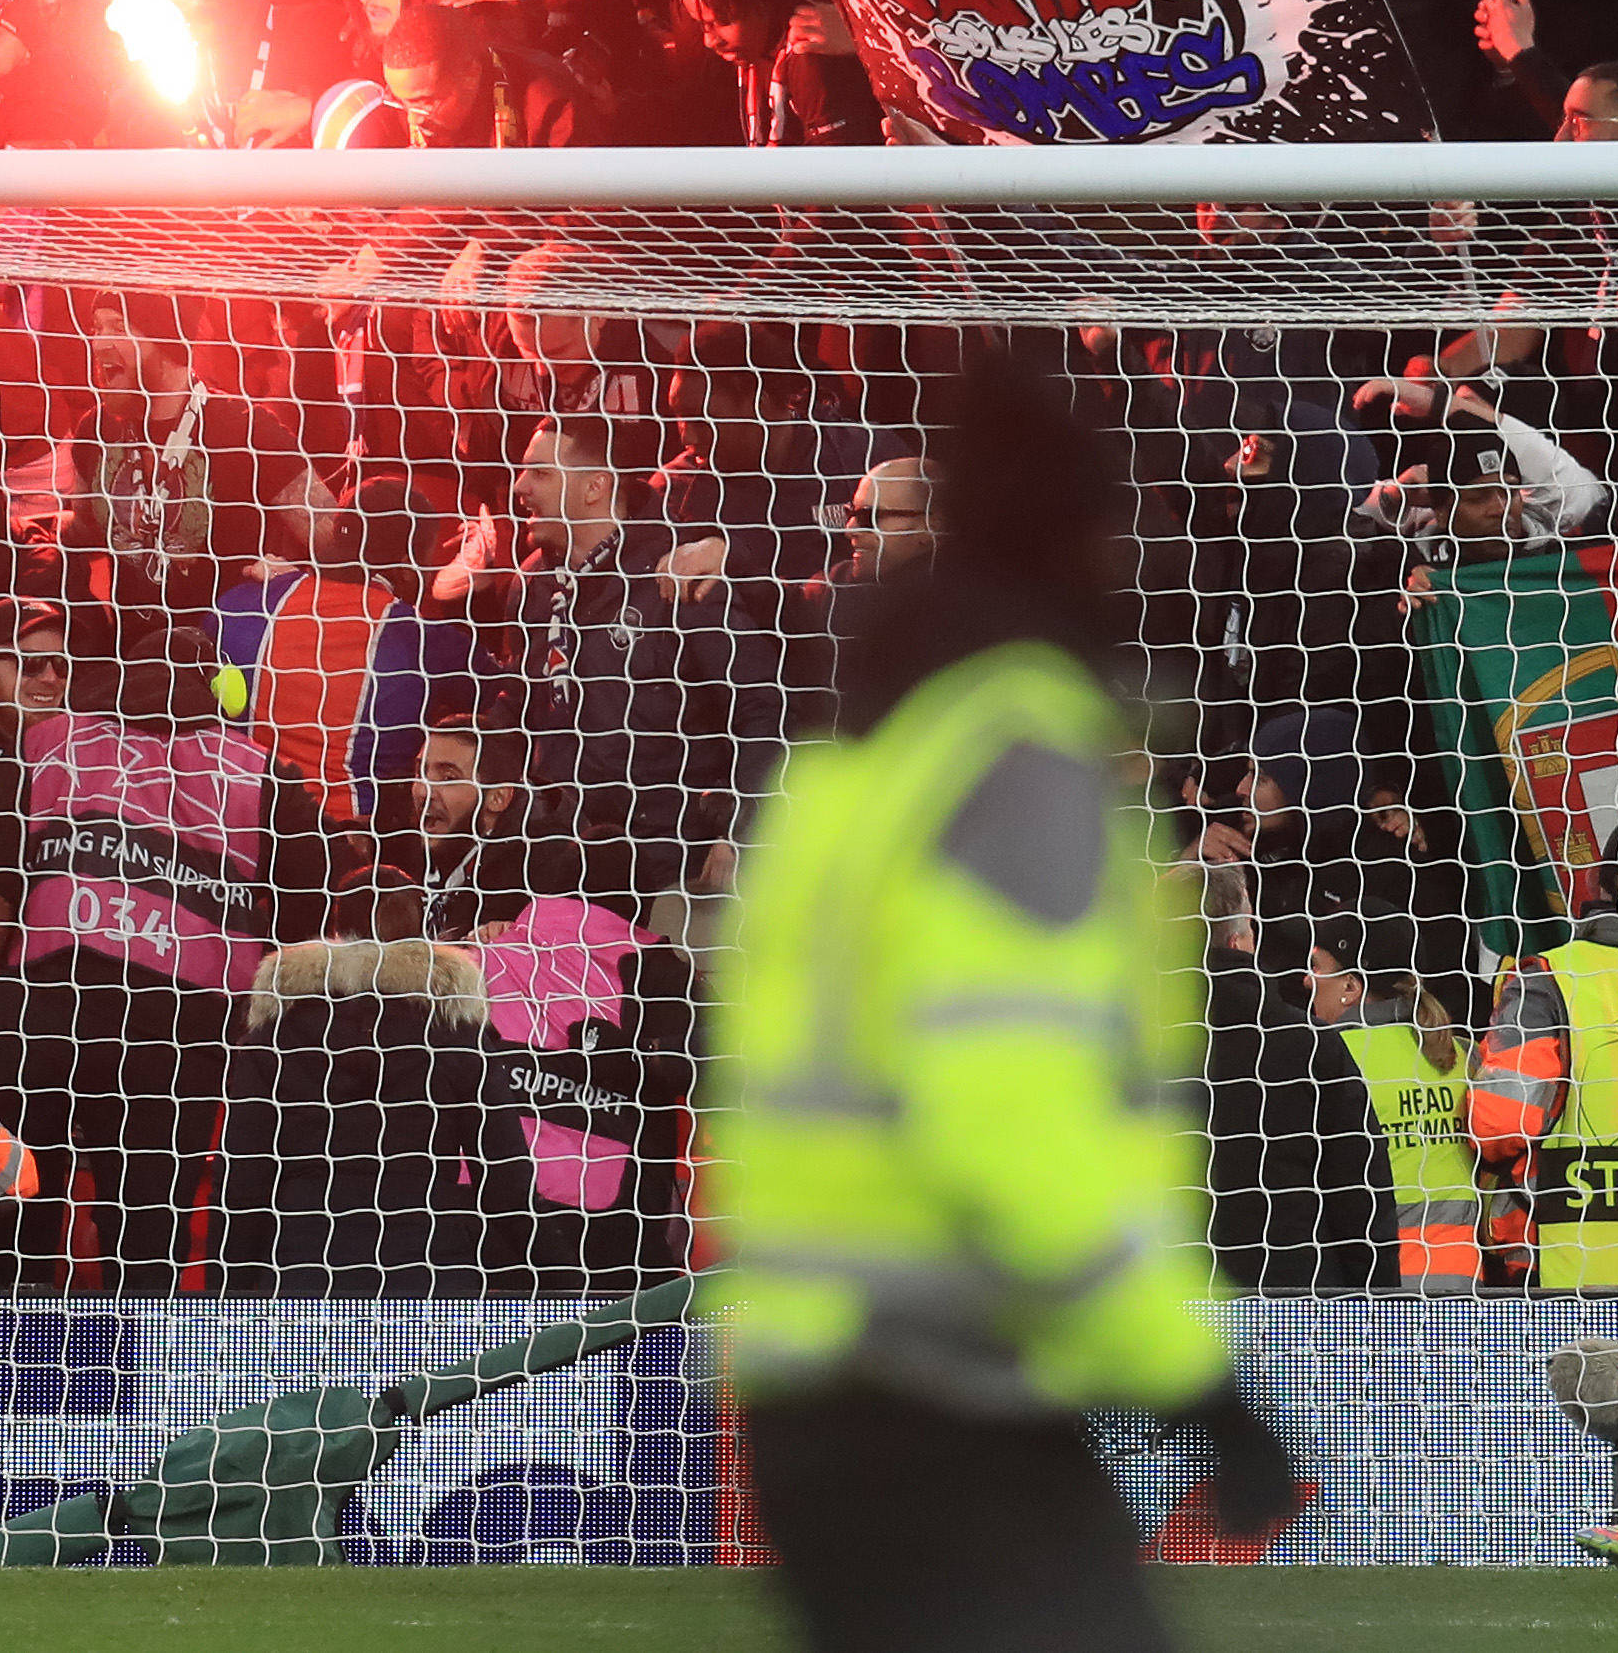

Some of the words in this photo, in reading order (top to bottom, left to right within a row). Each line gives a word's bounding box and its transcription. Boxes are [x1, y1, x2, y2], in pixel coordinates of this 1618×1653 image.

[907, 21, 1268, 143] BOMBES
[100, 835, 150, 868] FAN
[70, 886, 173, 958] 034
[508, 1066, 629, 1116] SUPPORT
[1398, 1086, 1455, 1117] HEAD
